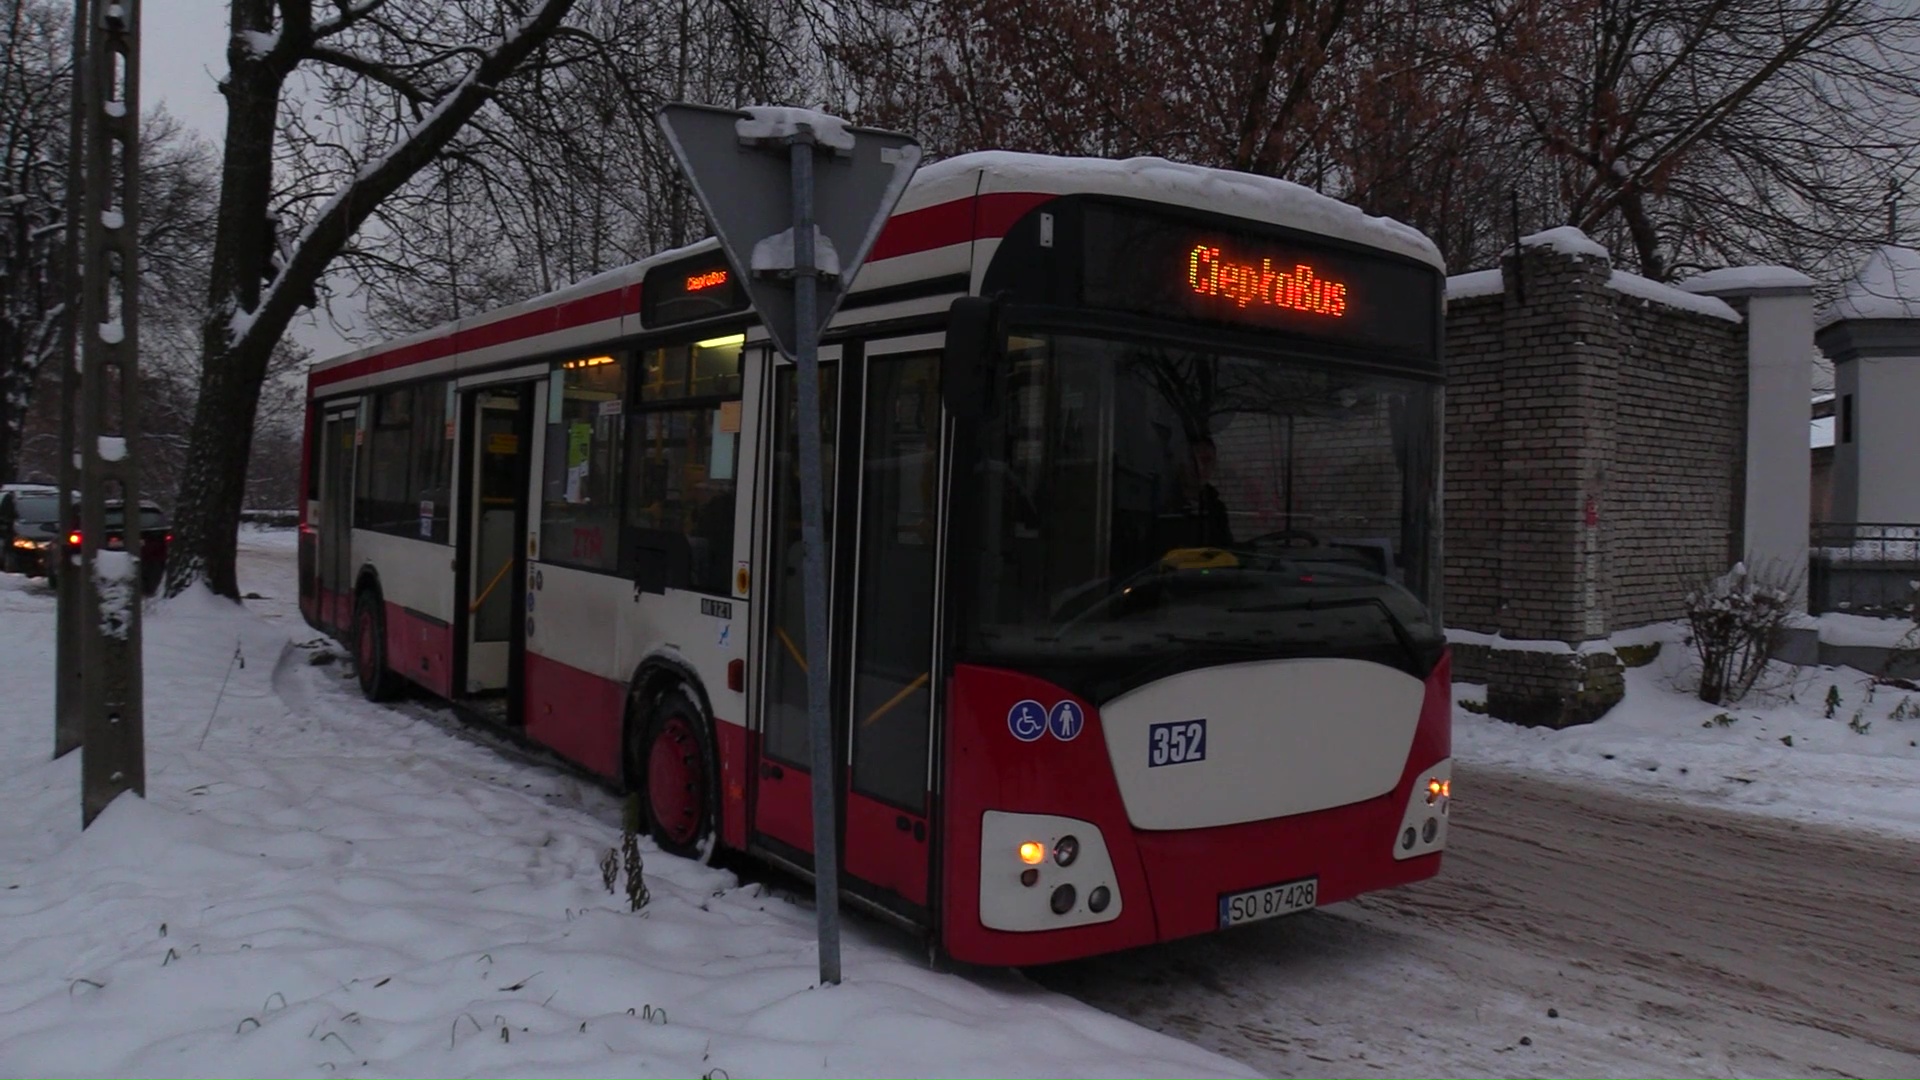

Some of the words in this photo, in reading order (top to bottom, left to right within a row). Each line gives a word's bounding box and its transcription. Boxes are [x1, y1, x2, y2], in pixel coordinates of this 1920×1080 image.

[1189, 245, 1347, 317] CiepłoBus
[1153, 723, 1202, 765] 352
[1232, 895, 1257, 920] SO
[1264, 883, 1314, 913] 87428
